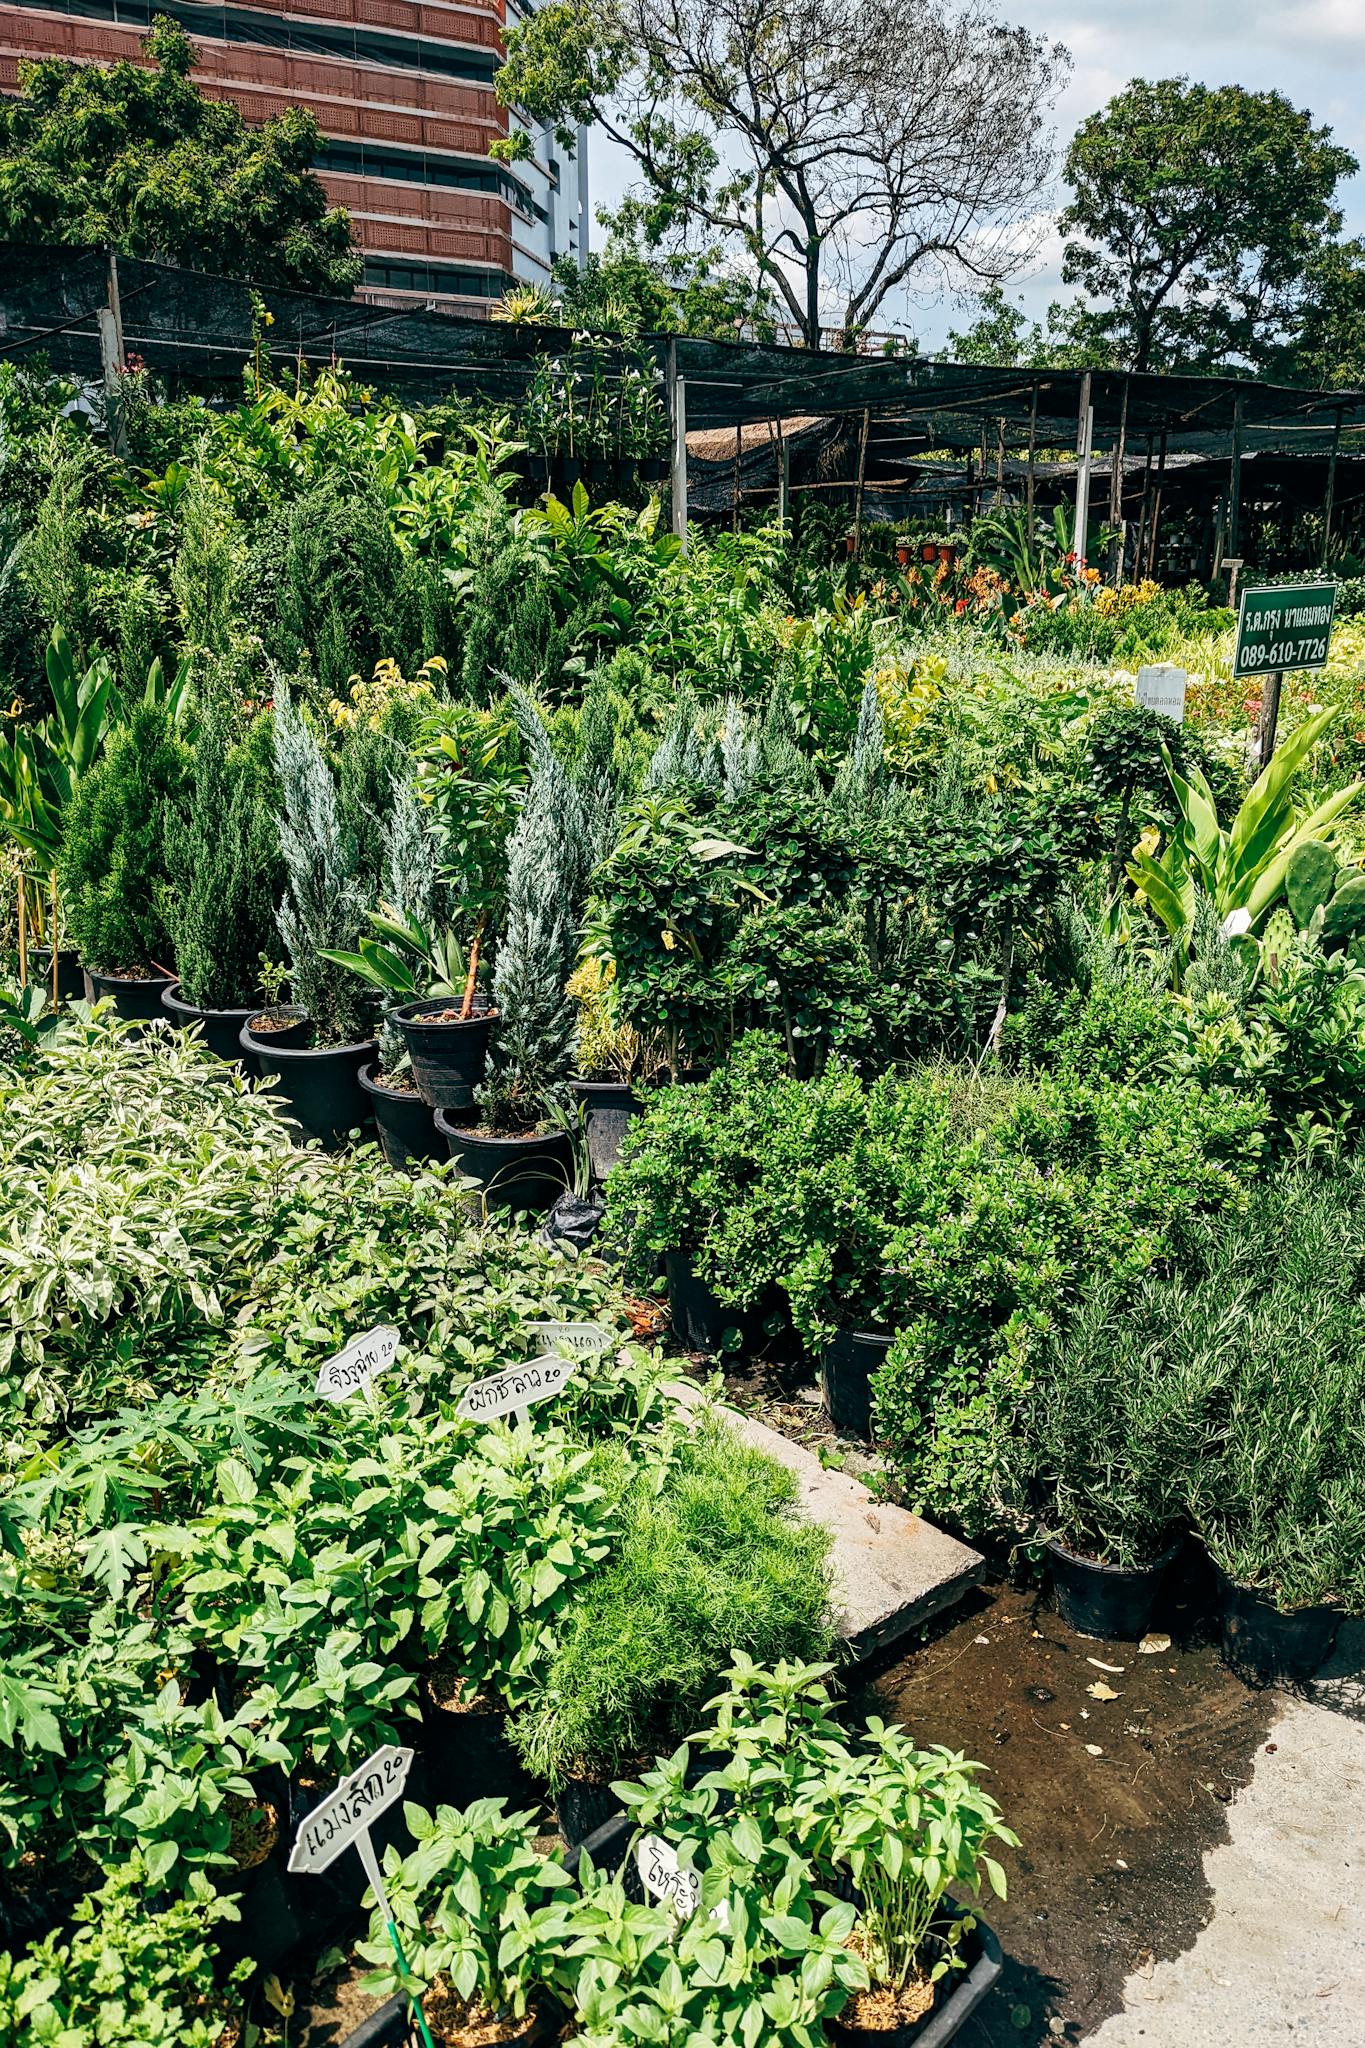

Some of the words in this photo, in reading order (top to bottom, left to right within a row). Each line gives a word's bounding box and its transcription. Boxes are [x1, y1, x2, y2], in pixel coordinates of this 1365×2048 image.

[1240, 637, 1327, 668] 089-610-7726
[381, 1341, 393, 1357] 20
[469, 1369, 542, 1411] ผักชีลาว
[545, 1368, 561, 1383] 20
[306, 1772, 385, 1856] แมงลัก
[383, 1756, 403, 1784] 20
